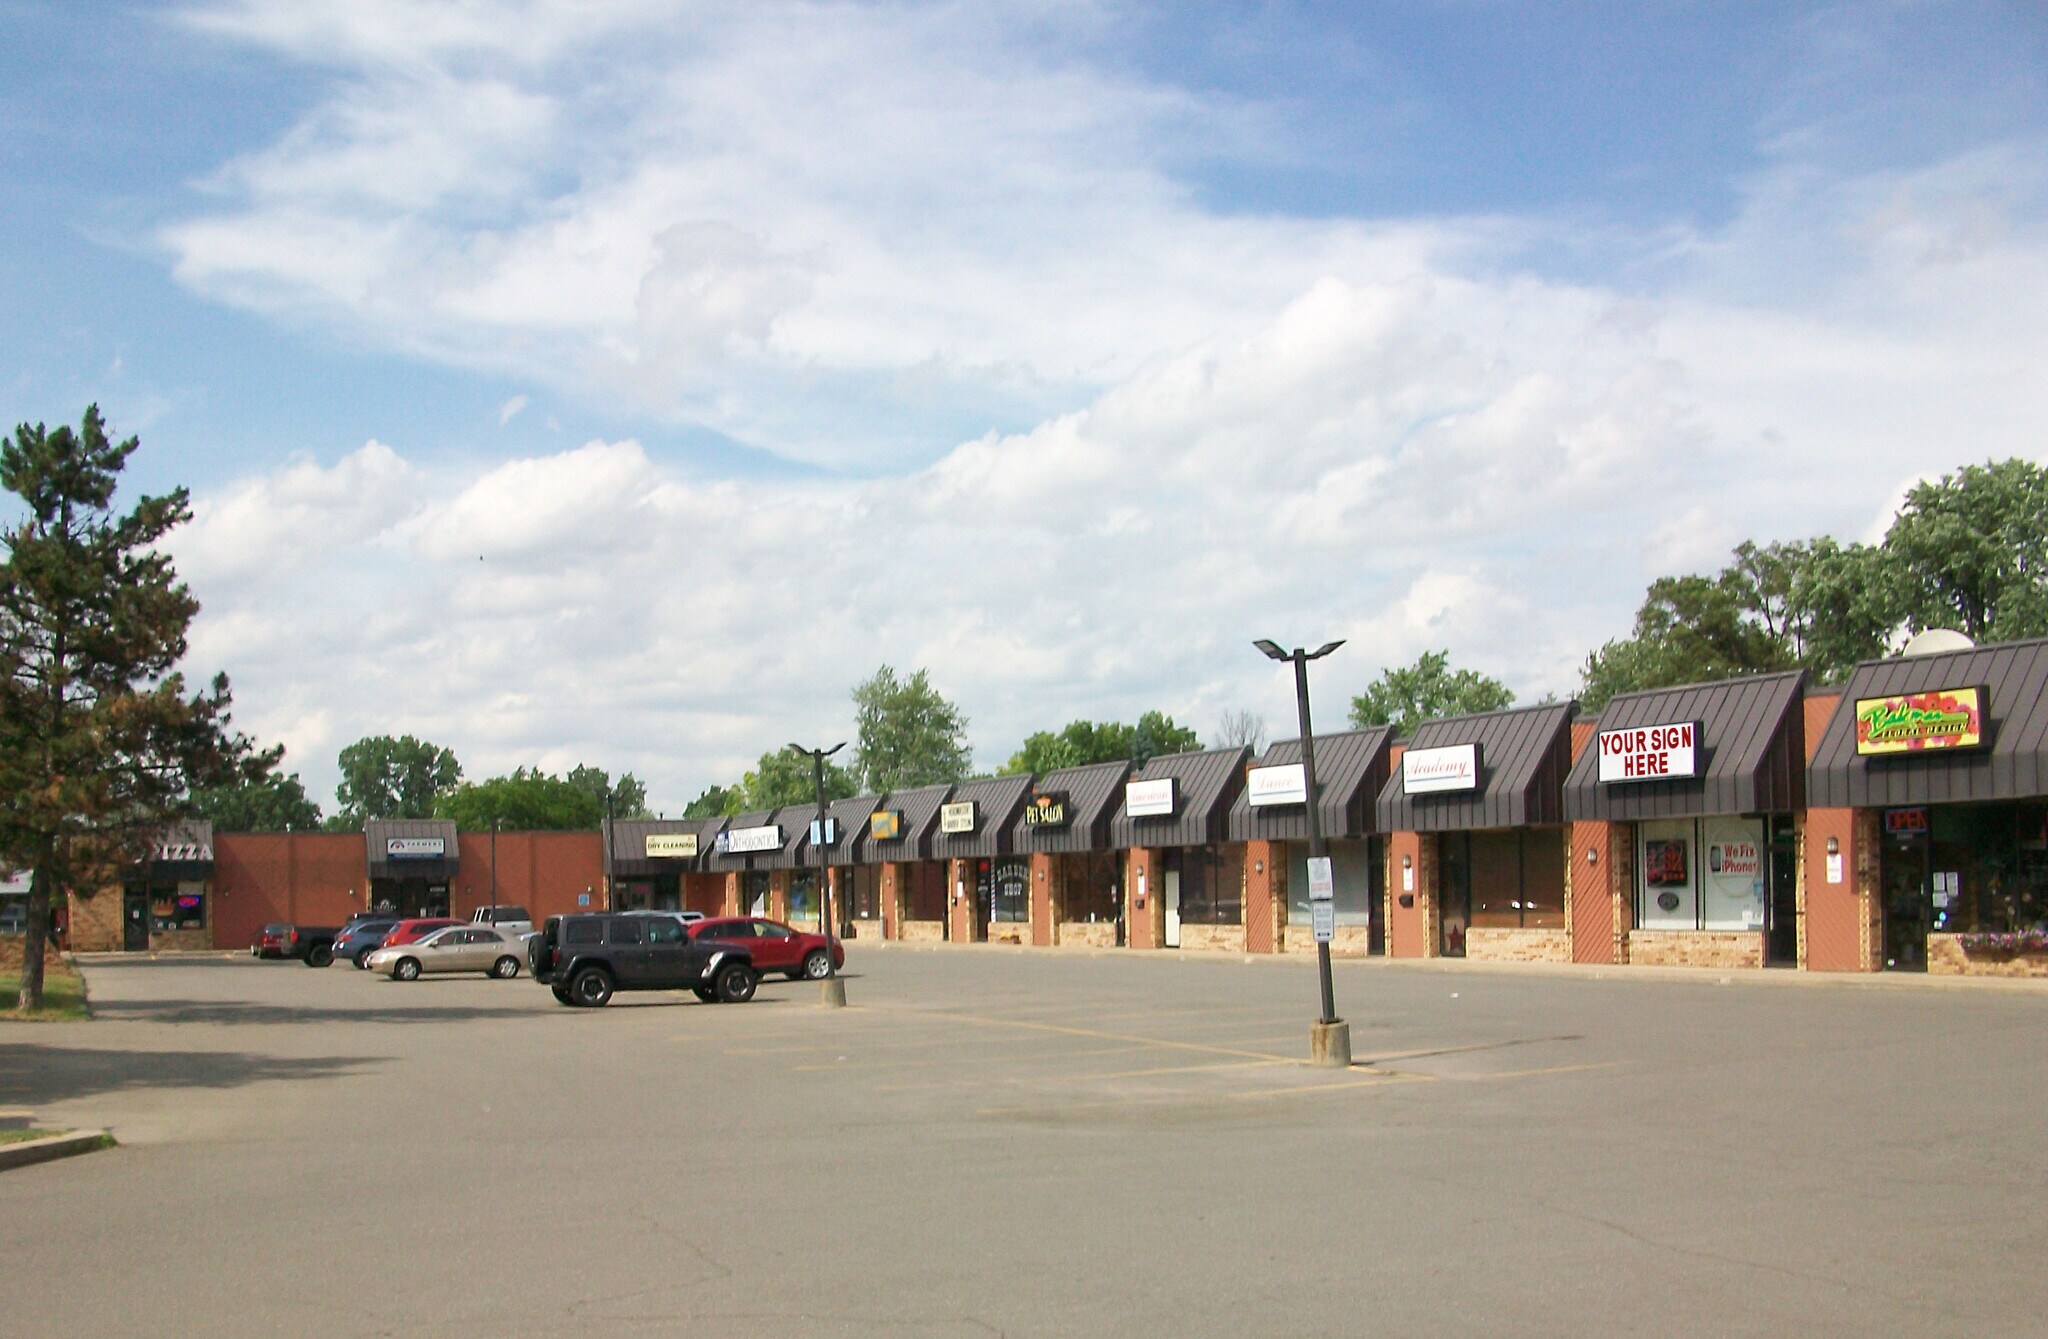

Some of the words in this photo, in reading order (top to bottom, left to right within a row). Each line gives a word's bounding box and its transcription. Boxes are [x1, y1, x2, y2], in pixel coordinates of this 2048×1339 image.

[1601, 731, 1647, 755] YOUR
[1651, 726, 1691, 750] SIGN
[1406, 757, 1467, 779] Academy
[1624, 752, 1668, 776] HERE
[1026, 805, 1038, 824] PET
[1040, 804, 1063, 823] SALON
[1888, 810, 1927, 830] OPEN
[730, 831, 776, 851] ORTHODONTICS
[1725, 844, 1739, 858] We
[1740, 844, 1755, 857] Fix
